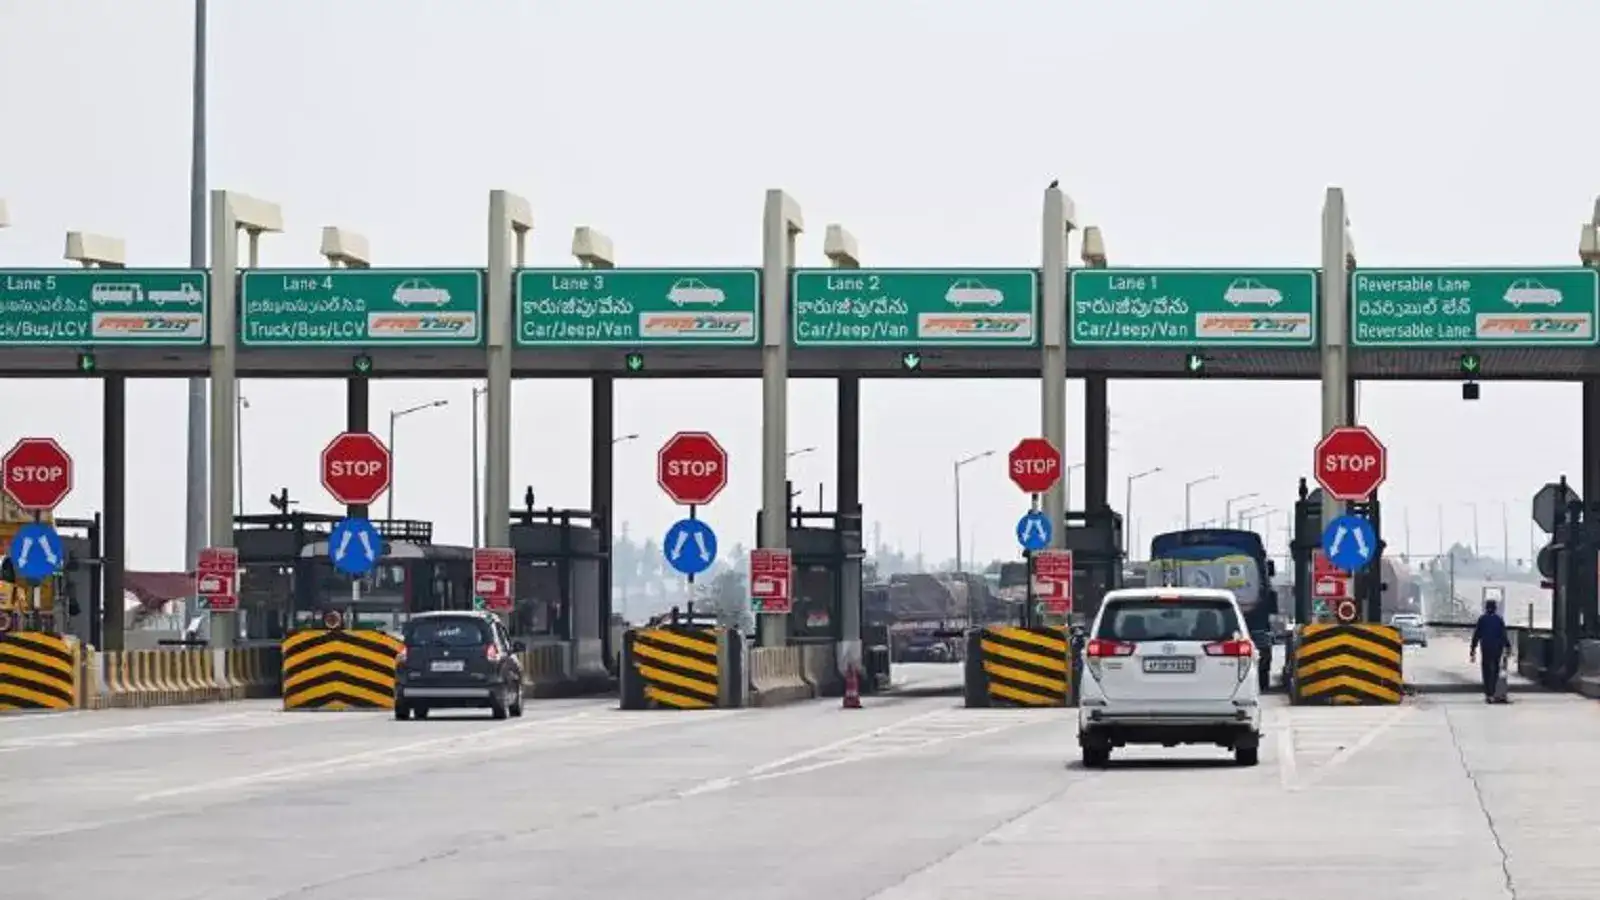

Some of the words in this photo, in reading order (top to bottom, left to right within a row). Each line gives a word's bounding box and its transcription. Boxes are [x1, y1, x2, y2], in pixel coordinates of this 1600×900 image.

[7, 276, 41, 290] Lane
[46, 276, 57, 290] 5
[283, 276, 317, 290] Lane
[321, 276, 333, 290] 4
[552, 276, 588, 290] Lane
[594, 276, 605, 290] 3
[827, 276, 864, 290] Lane
[869, 276, 880, 290] 2
[1108, 276, 1145, 290] Lane
[1151, 276, 1158, 290] 1
[1358, 277, 1432, 292] Reversable
[1437, 278, 1471, 292] Lane
[251, 321, 366, 339] Truck/Bus/LCV
[523, 321, 632, 340] Car/Jeep/Van
[799, 321, 909, 340] Car/Jeep/Van
[1077, 321, 1188, 340] Car/Jeep/Van
[1358, 323, 1432, 338] Reversable
[1438, 323, 1471, 338] Lane
[330, 460, 382, 477] STOP
[668, 459, 718, 477] STOP
[1013, 459, 1057, 475] STOP
[1325, 454, 1377, 472] STOP
[11, 465, 63, 483] STOP
